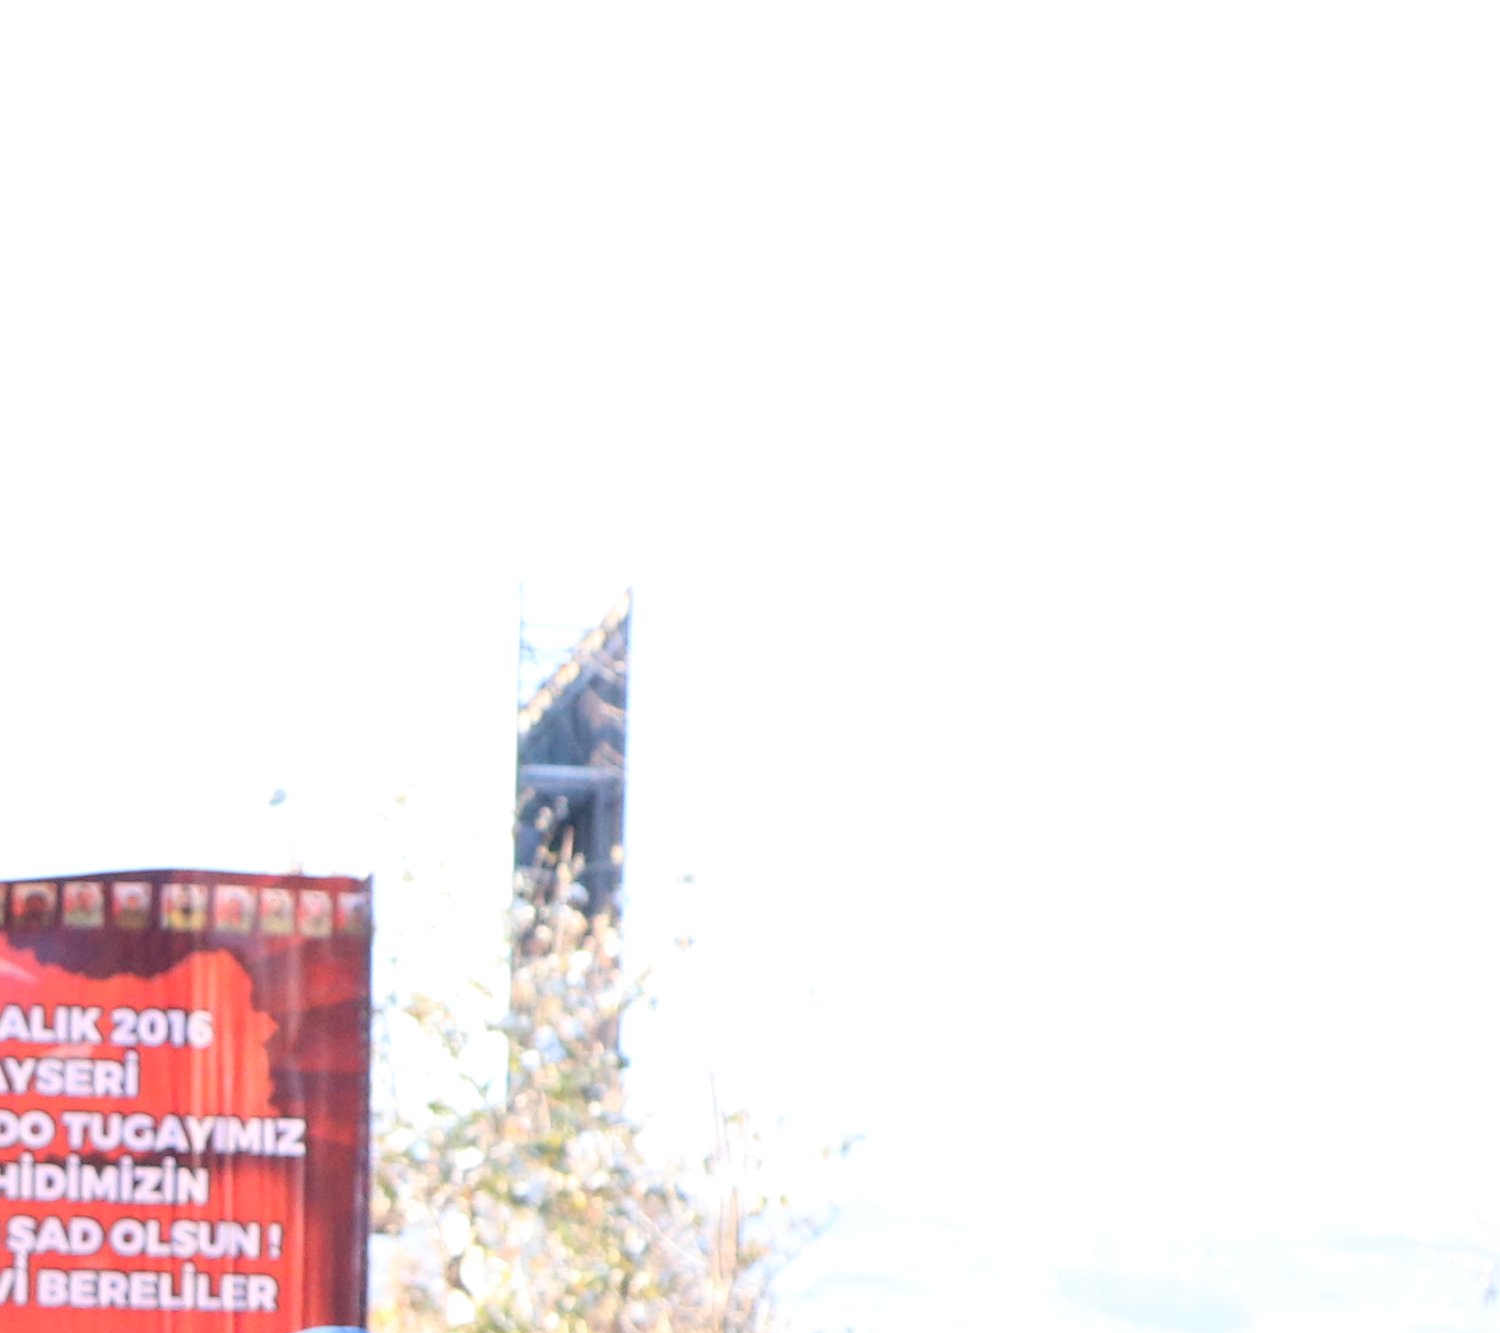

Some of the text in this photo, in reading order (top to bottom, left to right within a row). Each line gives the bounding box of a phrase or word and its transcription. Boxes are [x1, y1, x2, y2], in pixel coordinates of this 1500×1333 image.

[110, 1009, 214, 1049] 2016
[62, 1112, 307, 1156] TUGAYIMIZ
[7, 1215, 103, 1259] ŞAD
[110, 1219, 260, 1258] OLSUN
[37, 1264, 278, 1312] BERELİLER
